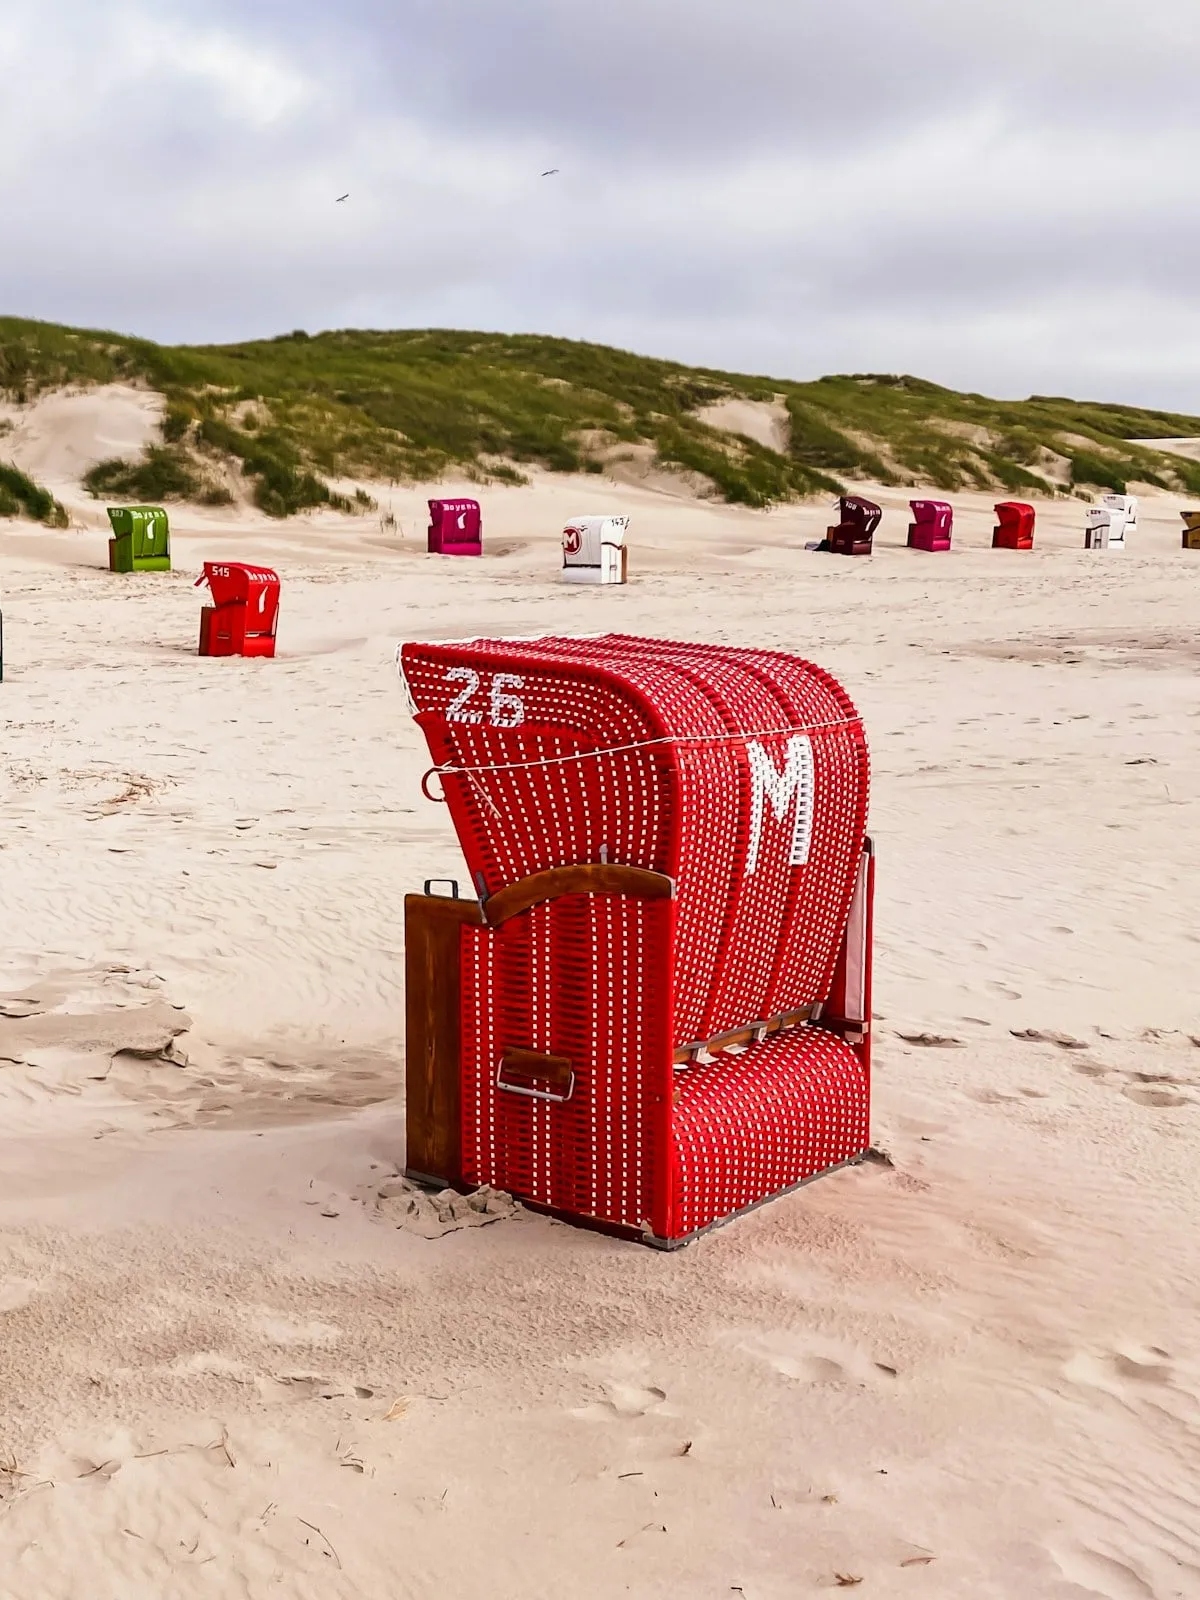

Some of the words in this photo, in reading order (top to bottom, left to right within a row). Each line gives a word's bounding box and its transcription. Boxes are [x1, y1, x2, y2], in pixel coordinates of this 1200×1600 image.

[563, 532, 577, 549] M
[212, 565, 230, 578] 515
[441, 667, 525, 728] 26
[744, 733, 815, 878] M
